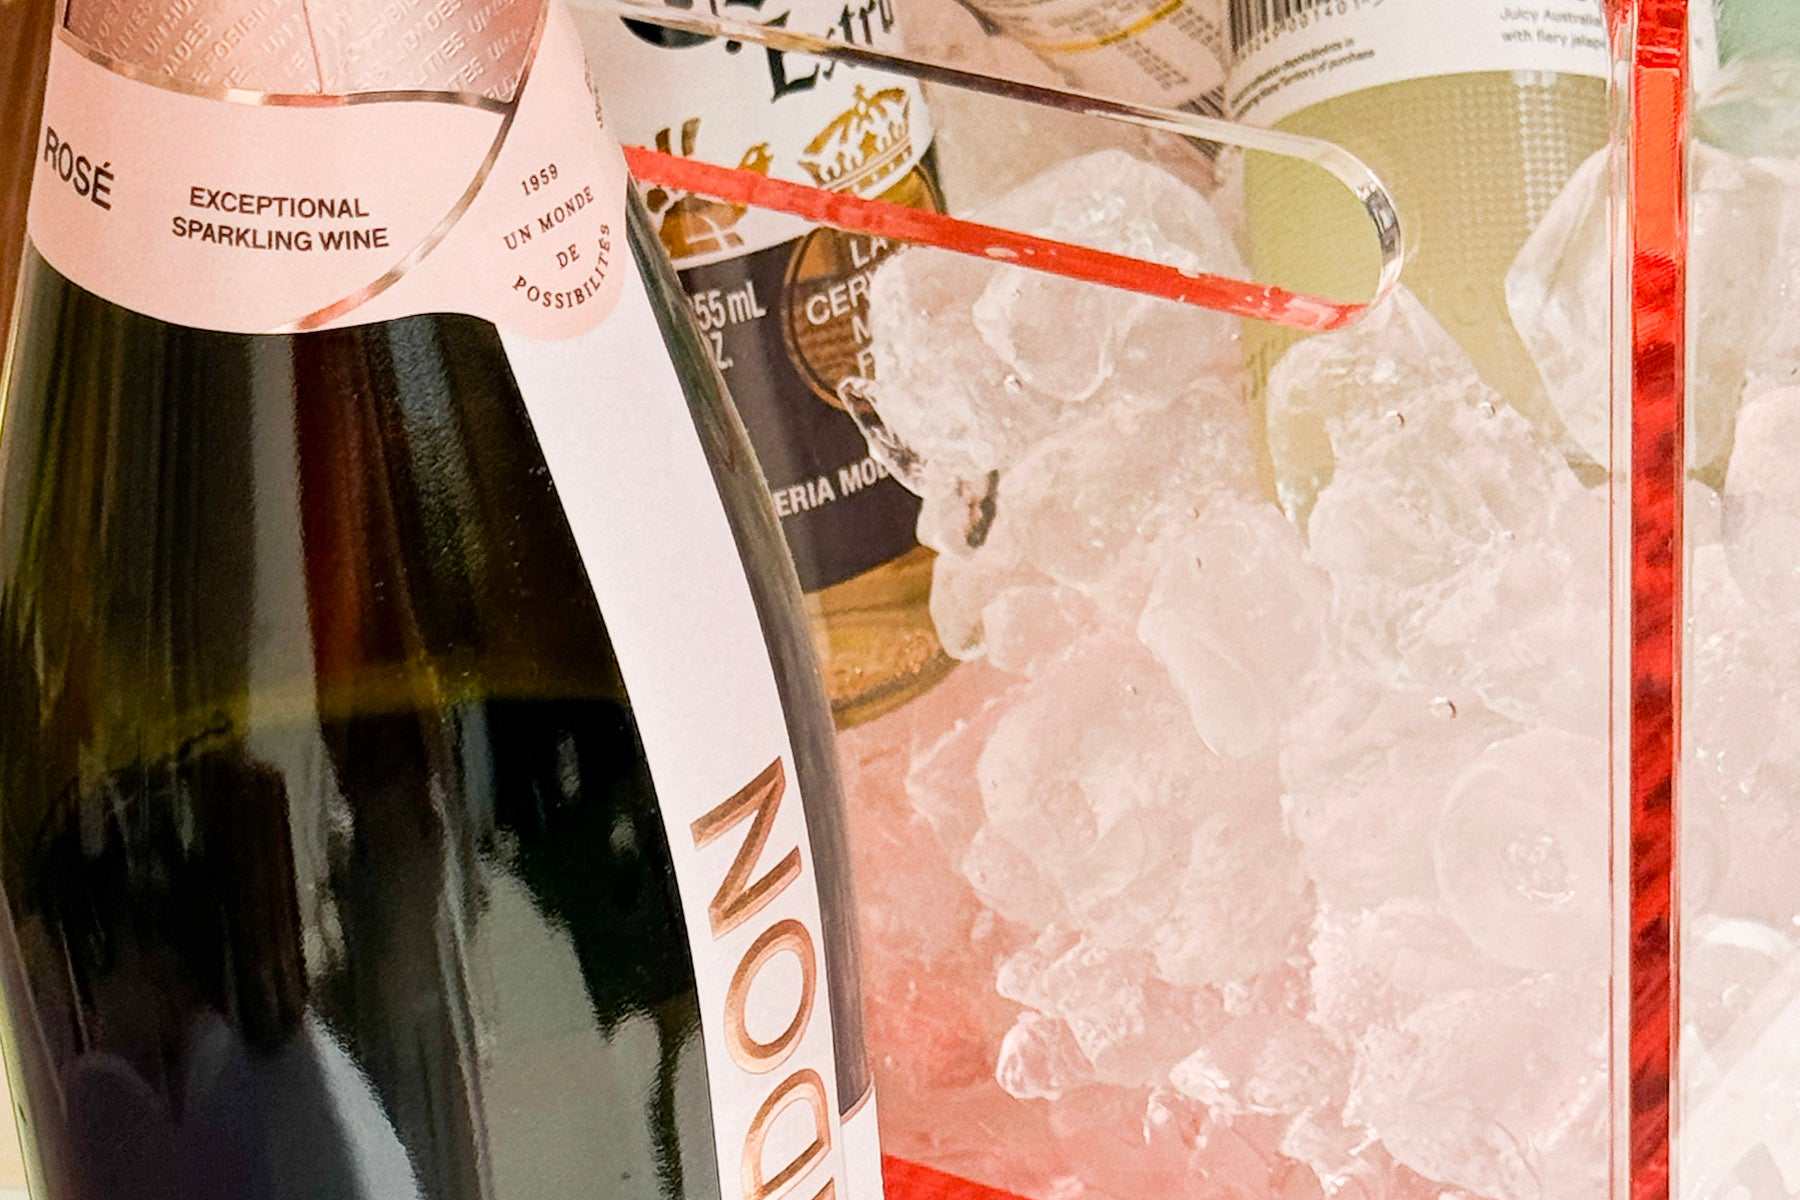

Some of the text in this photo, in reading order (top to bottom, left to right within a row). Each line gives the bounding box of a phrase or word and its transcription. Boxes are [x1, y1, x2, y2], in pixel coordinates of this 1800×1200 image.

[1543, 10, 1601, 26] Australia
[1501, 29, 1532, 42] with
[44, 125, 114, 211] ROSÉ
[521, 163, 558, 196] 1959
[189, 186, 370, 218] EXCEPTIONAL
[503, 186, 594, 250] UN MONDE
[171, 216, 389, 251] SPARKLING WINE
[555, 243, 580, 268] DE
[693, 288, 726, 331] 55
